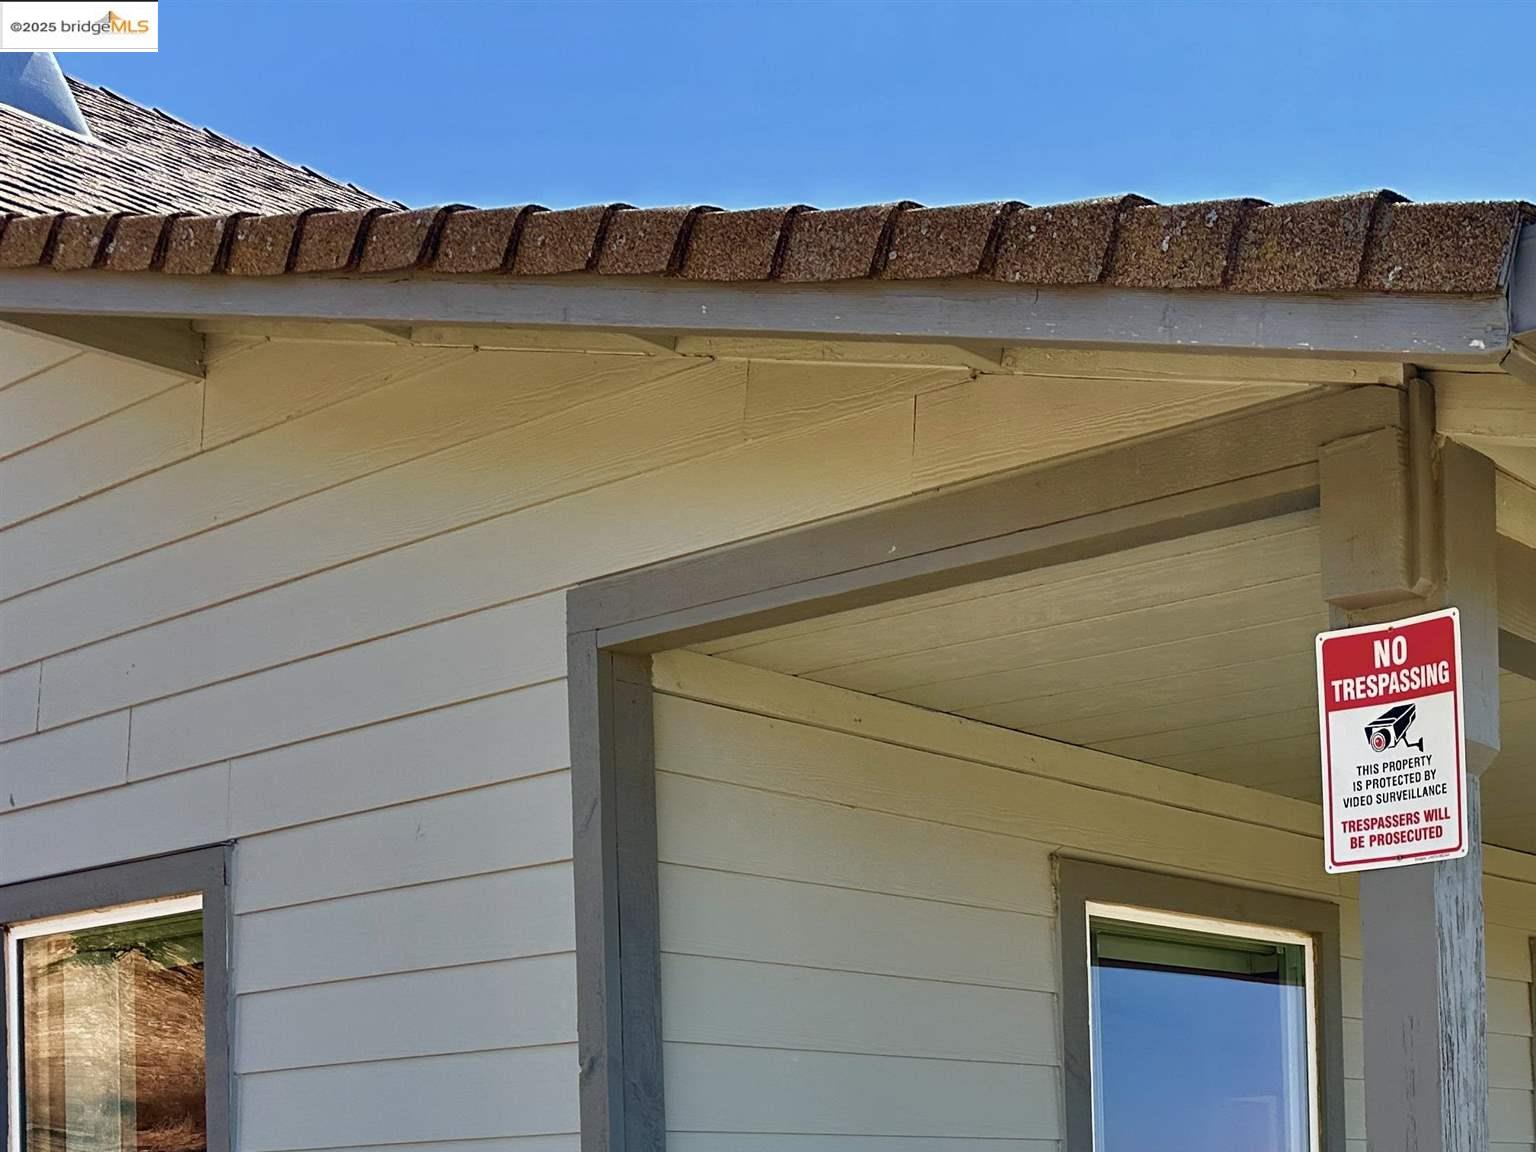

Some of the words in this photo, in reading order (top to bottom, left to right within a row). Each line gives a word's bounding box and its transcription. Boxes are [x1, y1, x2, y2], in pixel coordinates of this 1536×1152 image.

[1373, 635, 1408, 669] NO
[1331, 660, 1450, 703] TRESPASSING
[1356, 763, 1379, 776] THIS
[1382, 755, 1433, 773] PROPERTY
[1352, 780, 1363, 792] IS
[1365, 772, 1421, 790] PROTECTED
[1424, 769, 1437, 781] BY
[1343, 794, 1373, 809] VIDEO
[1376, 783, 1447, 804] SURVEILLANCE
[1341, 811, 1420, 833] TRESPASSERS
[1423, 807, 1450, 822] WILL
[1350, 835, 1365, 849] BE
[1369, 825, 1443, 847] PROSECUTED
